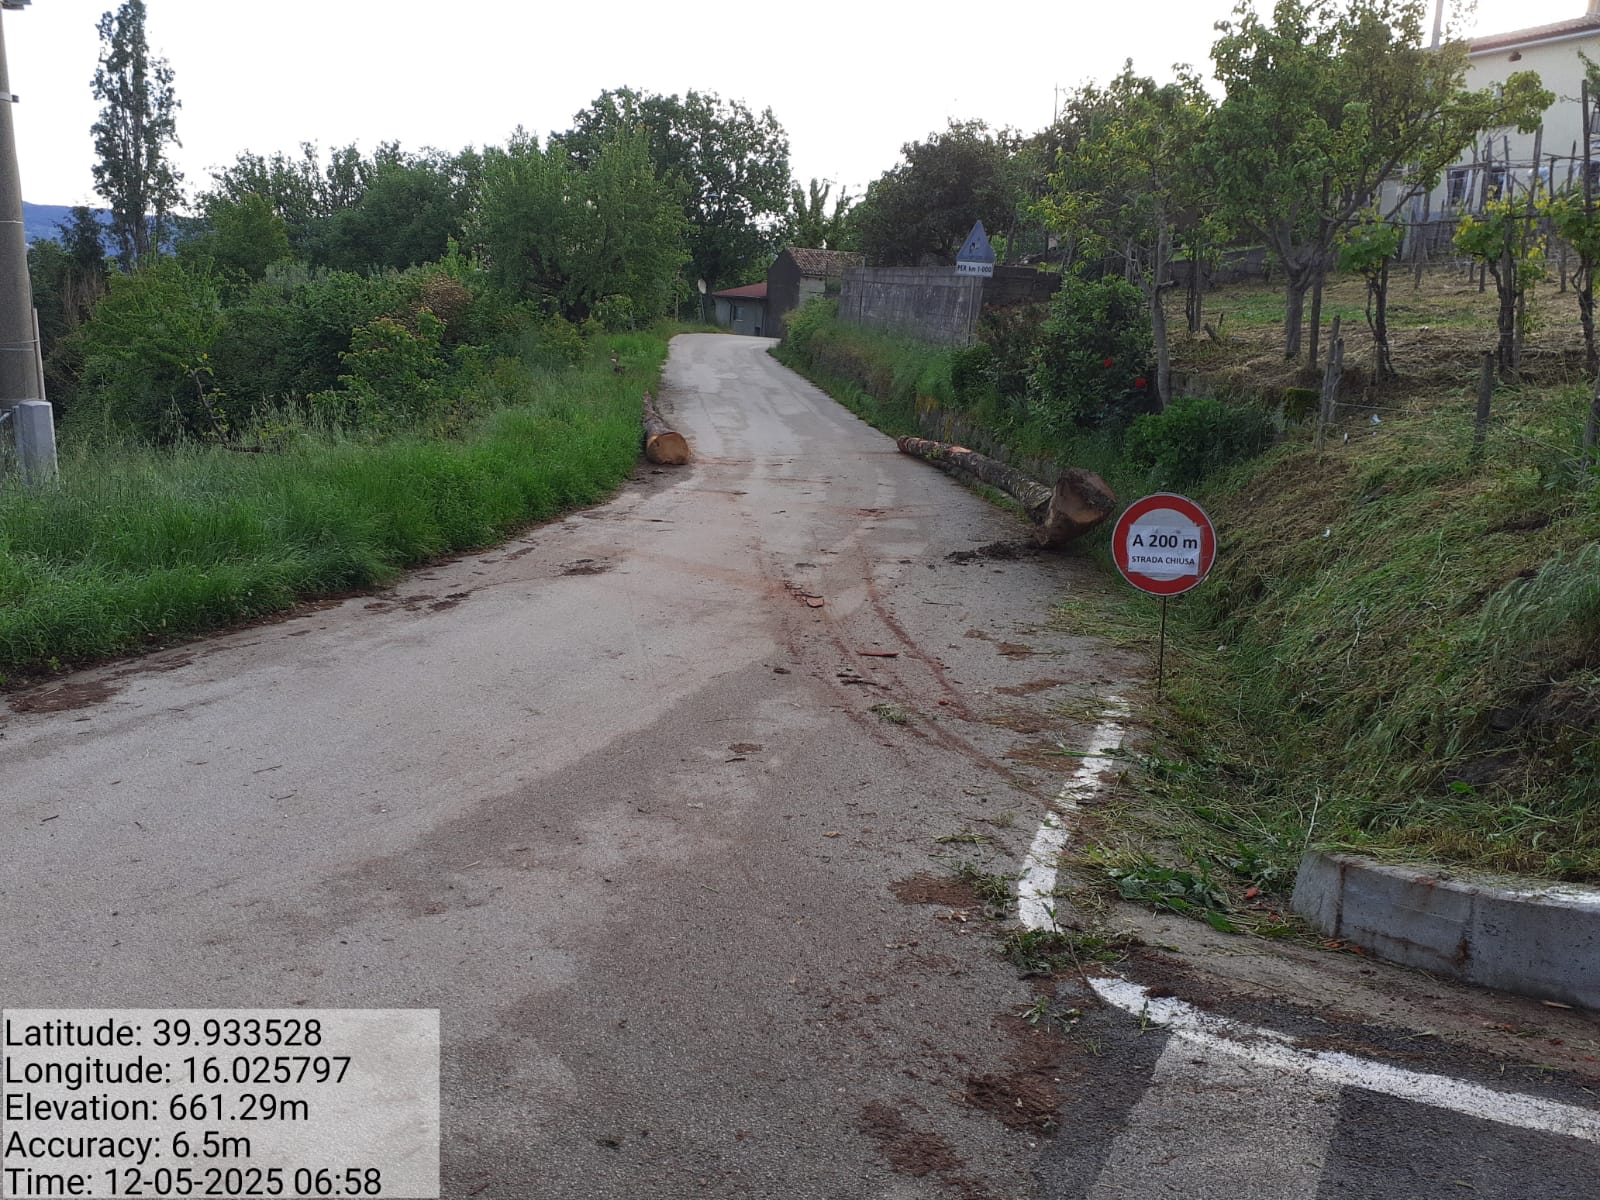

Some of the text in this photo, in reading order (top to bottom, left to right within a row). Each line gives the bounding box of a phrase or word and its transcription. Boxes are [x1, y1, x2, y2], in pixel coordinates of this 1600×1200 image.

[1132, 534, 1198, 549] A 200 m
[1131, 555, 1195, 566] STRADA CHIUSA
